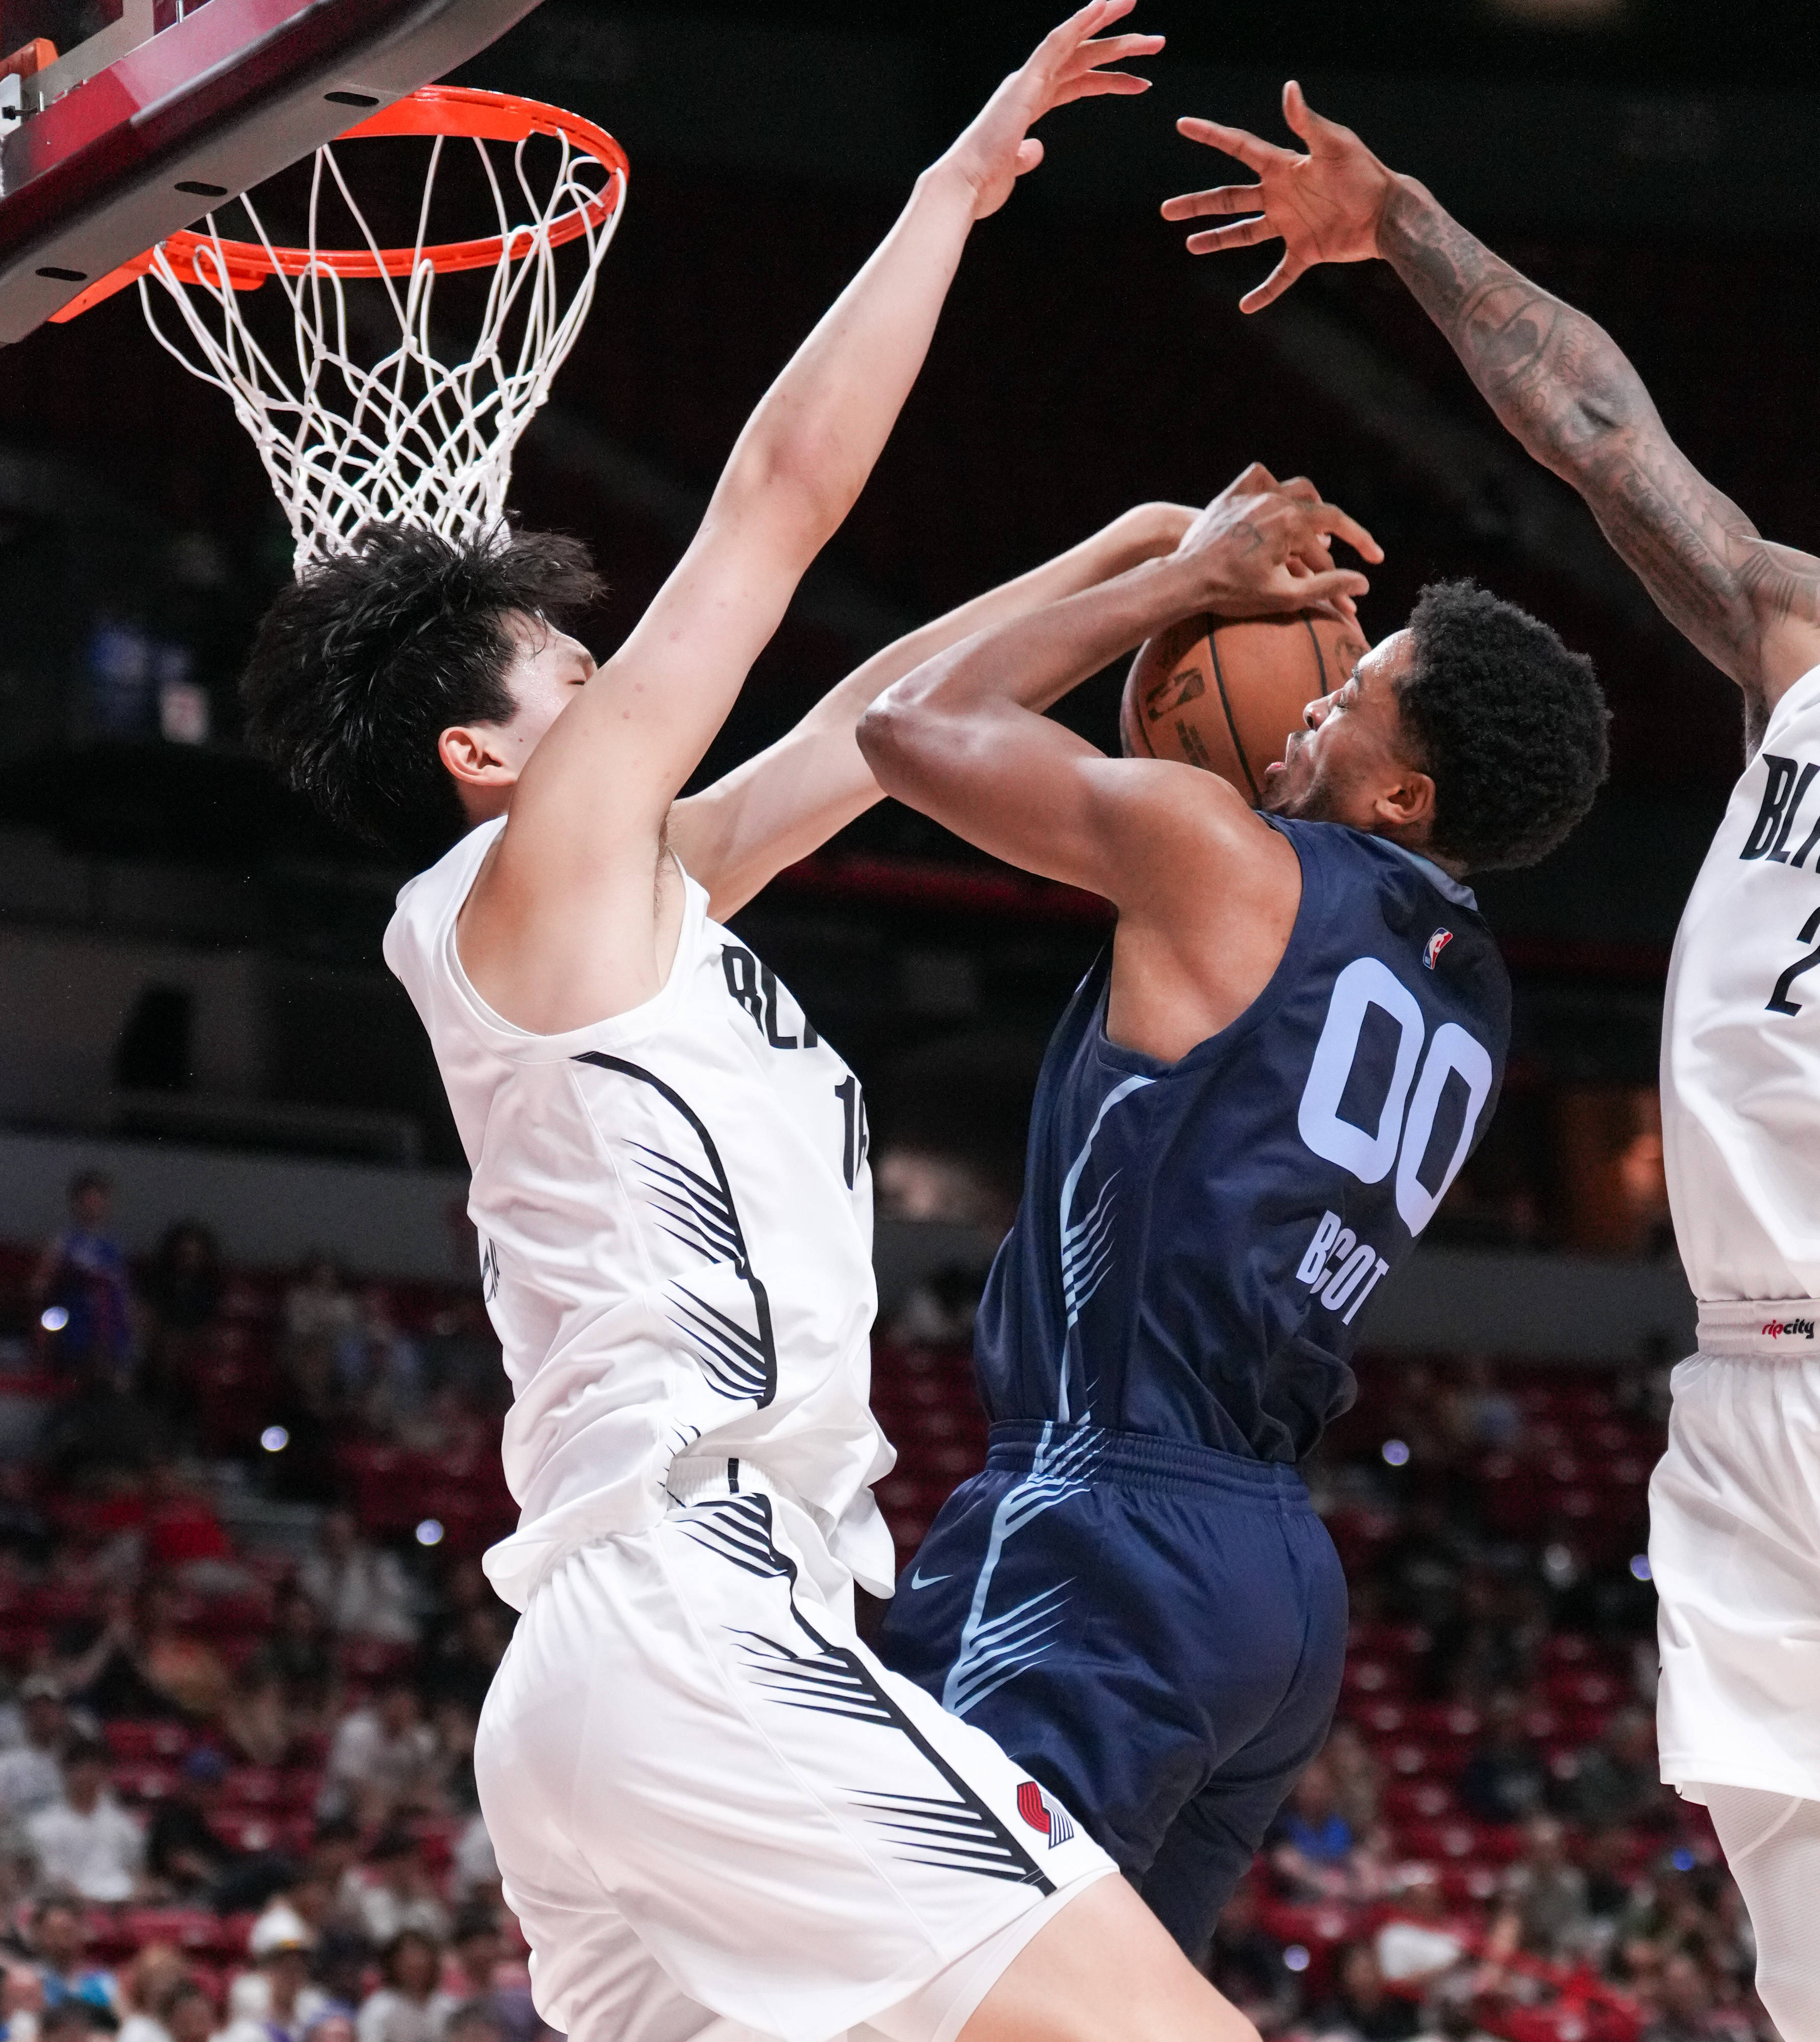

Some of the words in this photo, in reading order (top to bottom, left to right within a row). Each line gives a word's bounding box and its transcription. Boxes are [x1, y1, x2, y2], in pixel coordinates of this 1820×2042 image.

[721, 943, 818, 1049] BL
[1298, 957, 1492, 1237] 00
[1762, 1318, 1815, 1340] ripcity
